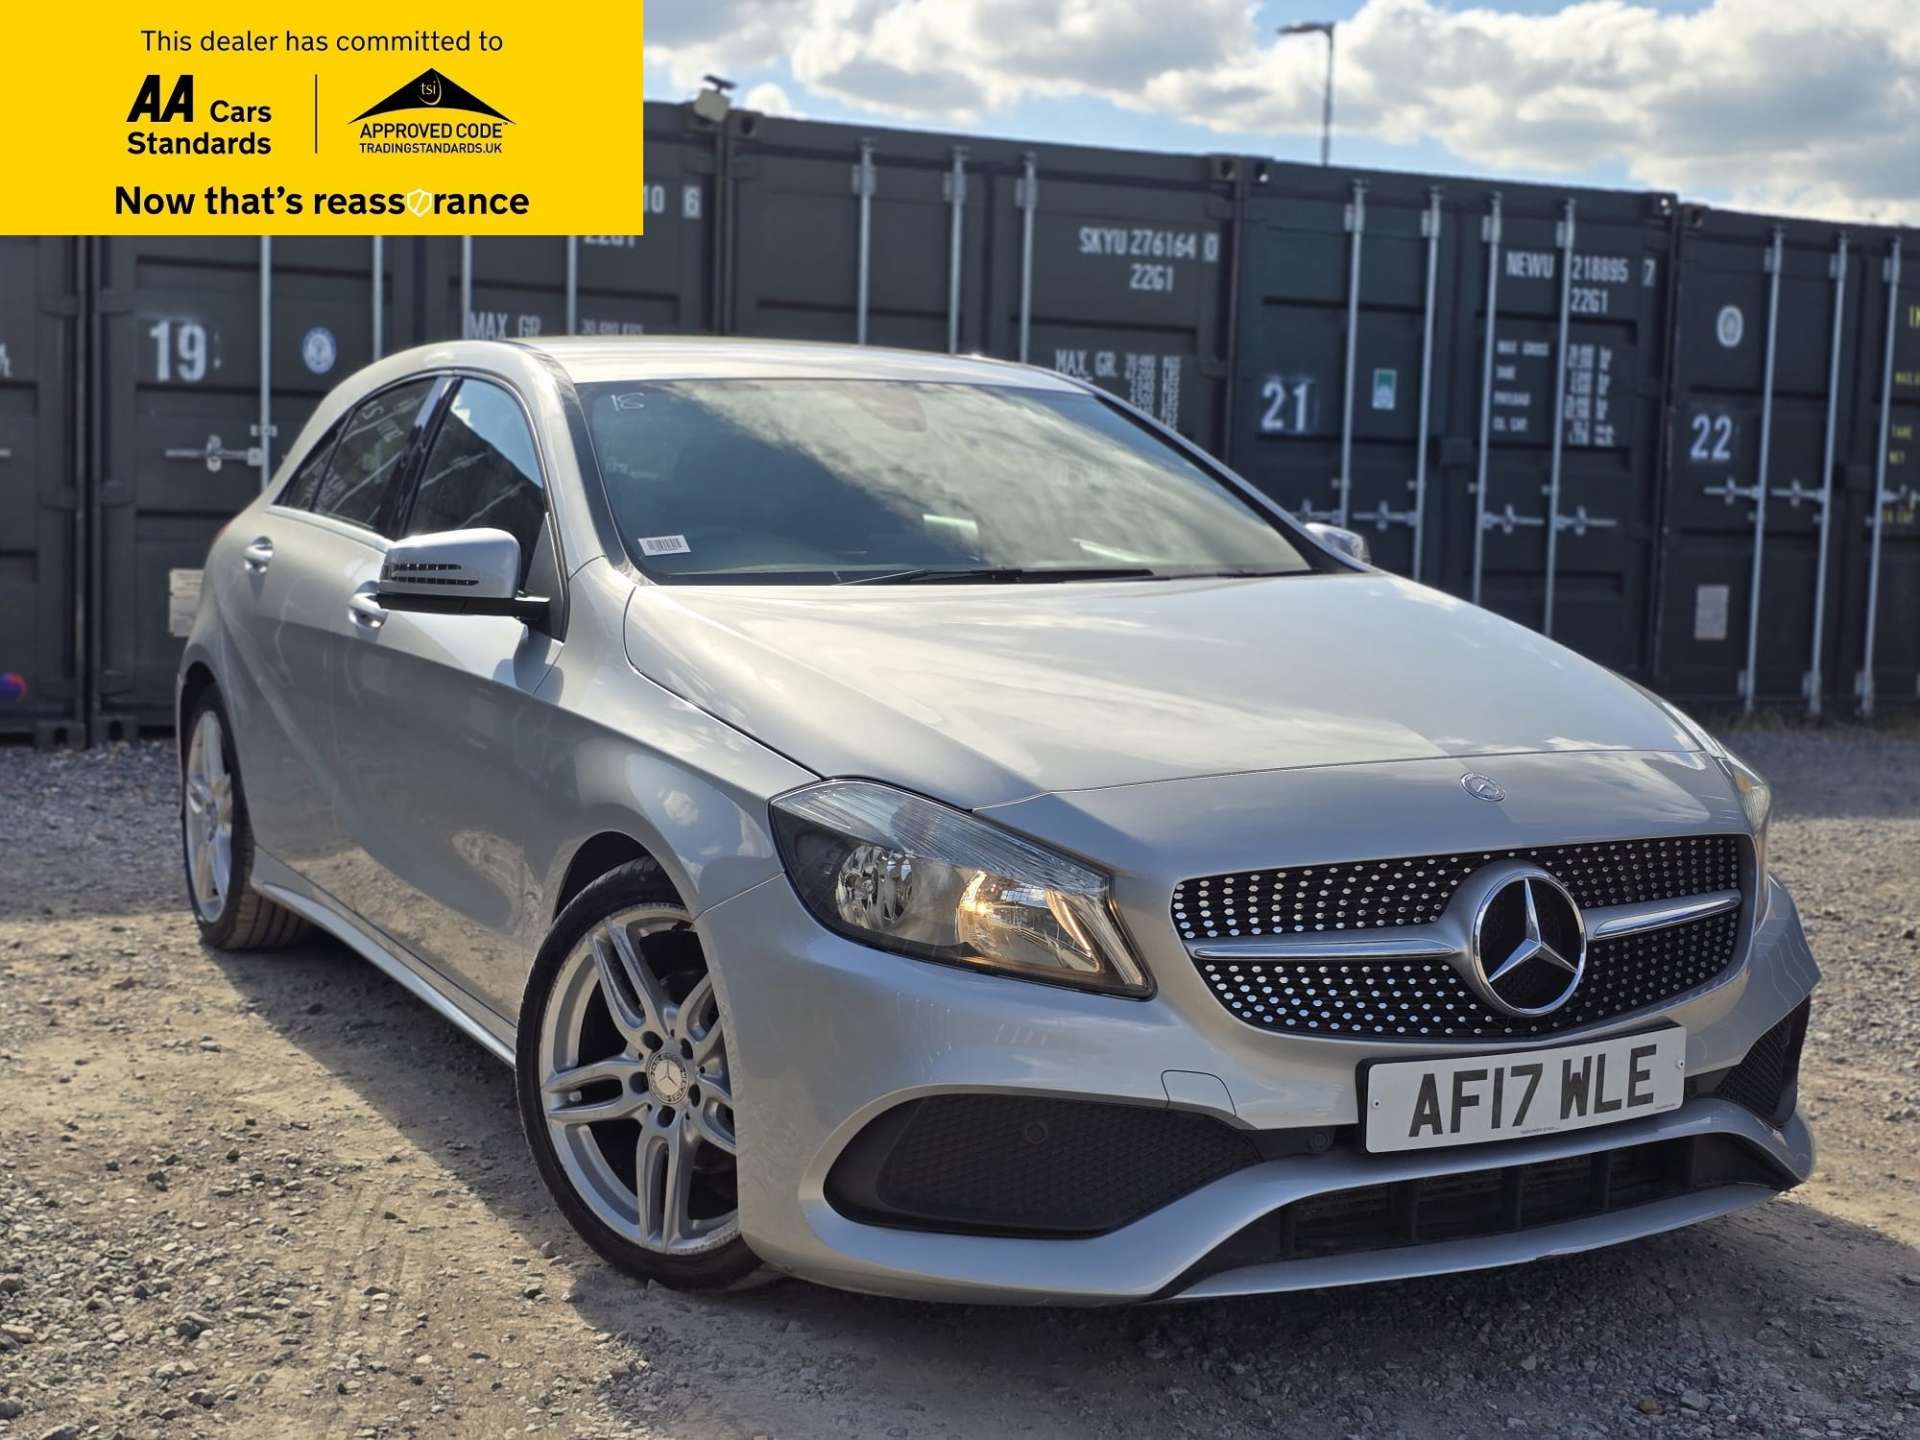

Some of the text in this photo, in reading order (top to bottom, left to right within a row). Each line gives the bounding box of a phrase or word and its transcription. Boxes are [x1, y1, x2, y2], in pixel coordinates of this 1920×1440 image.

[1130, 229, 1197, 259] 276164
[1506, 252, 1554, 279] NEWU
[149, 321, 207, 383] 19
[1261, 381, 1308, 433] 21
[1690, 413, 1732, 461] 22
[1408, 1044, 1657, 1138] AF17 WLE
